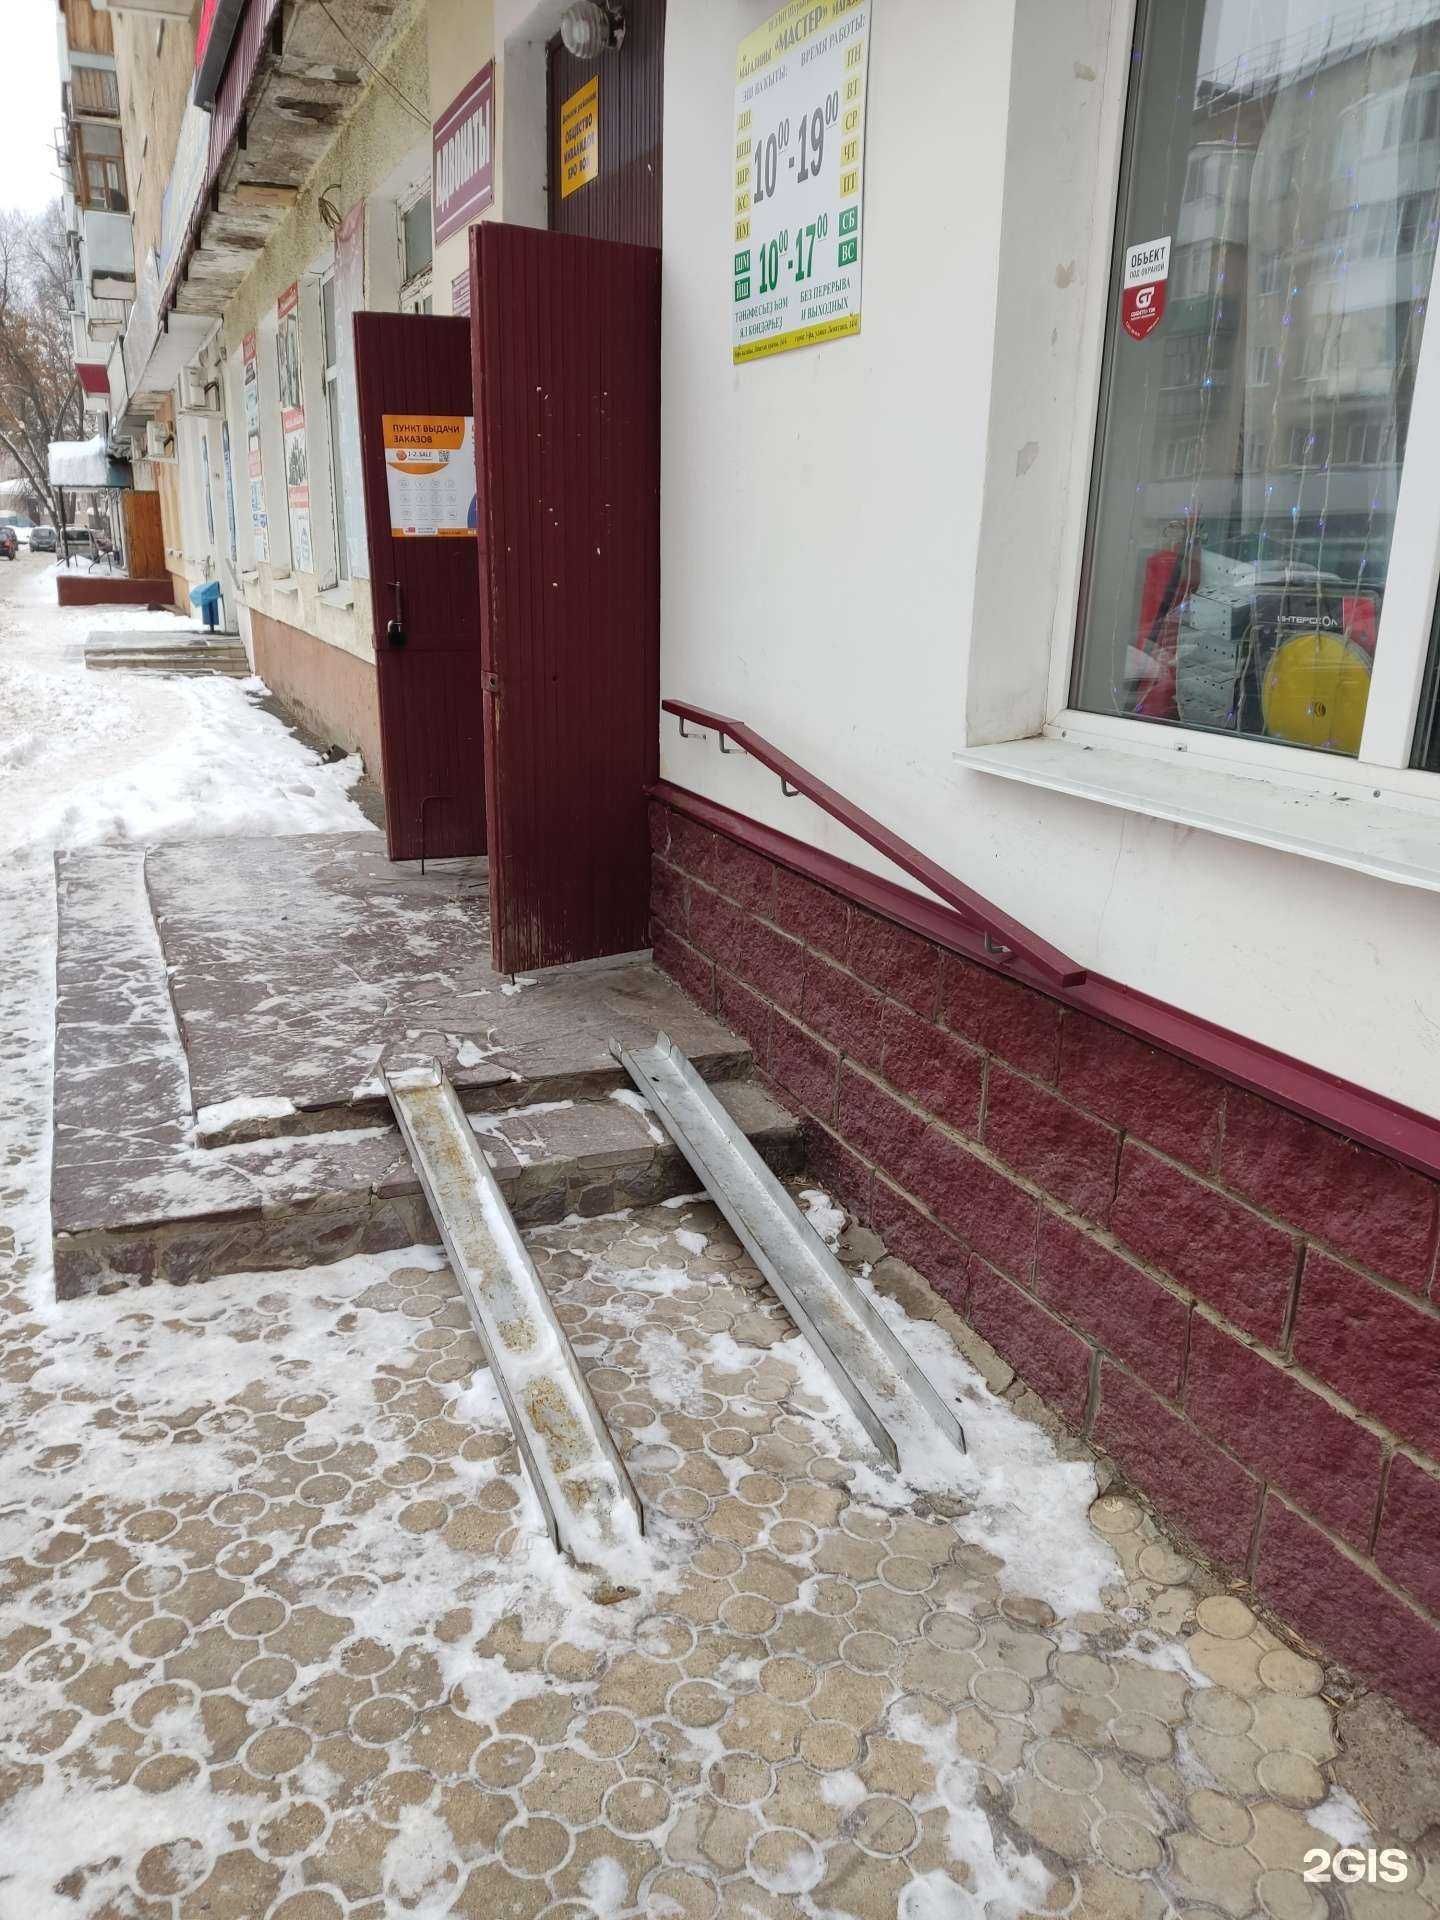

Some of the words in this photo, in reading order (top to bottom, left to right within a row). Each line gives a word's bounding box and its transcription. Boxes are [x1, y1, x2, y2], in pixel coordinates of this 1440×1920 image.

[775, 5, 827, 50] «МАСТЕР»
[801, 37, 827, 67] ВРЕМЯ
[830, 14, 865, 49] РАБОТЫ:
[847, 43, 861, 67] ПН
[846, 78, 858, 99] ВТ
[566, 112, 593, 144] ОБЩЕСТВО
[846, 110, 857, 130] СР
[436, 98, 490, 213] АДВОКАТЫ
[844, 141, 857, 160] ЧТ
[844, 171, 857, 193] ПТ
[737, 193, 749, 212] КС
[842, 211, 854, 230] СБ
[842, 242, 854, 262] ВС
[1131, 247, 1165, 268] ОБЪЕКТ
[1129, 270, 1140, 279] ПОД
[800, 288, 812, 302] БЕЗ
[813, 277, 850, 299] ПЕРЕРЫВА
[807, 297, 848, 319] ВЫХОДНЫХ
[393, 424, 421, 433] ПУНКТ
[423, 424, 460, 434] ВЫДАЧИ
[393, 434, 433, 443] ЗАКАЗОВ
[1277, 615, 1338, 627] ИНТЕРСКОЛ
